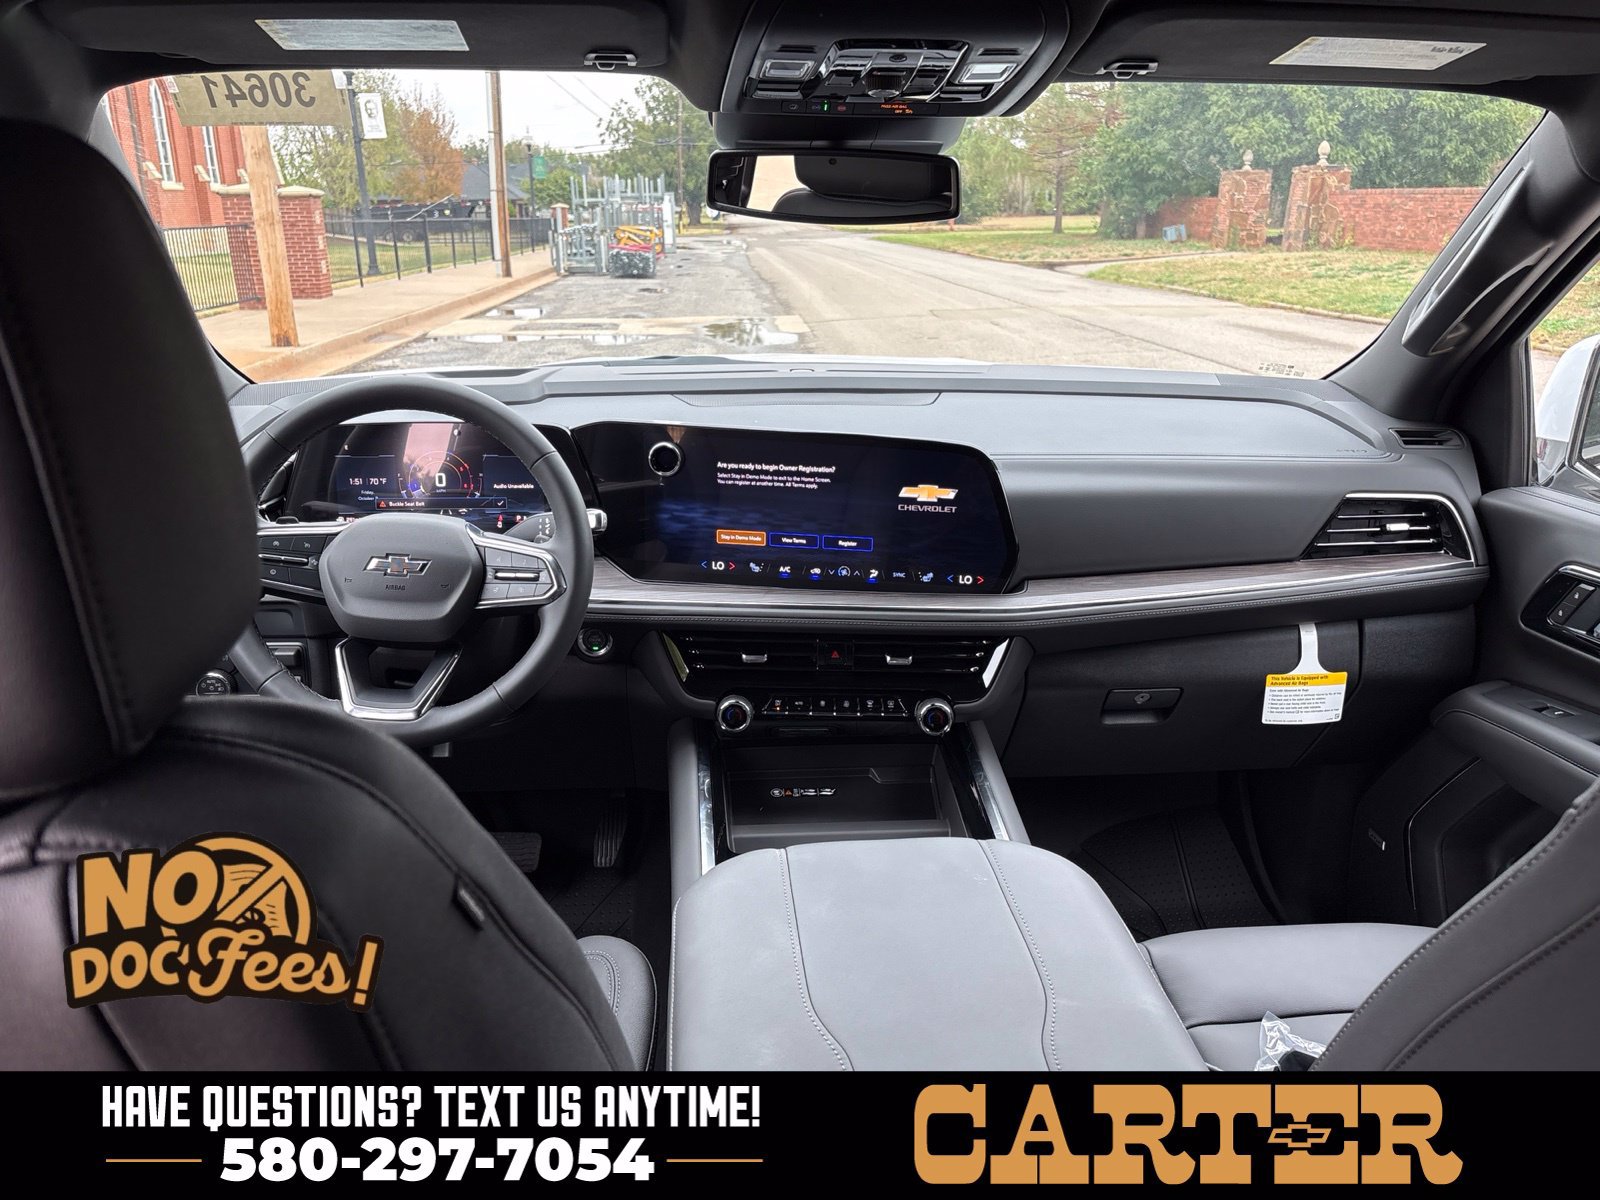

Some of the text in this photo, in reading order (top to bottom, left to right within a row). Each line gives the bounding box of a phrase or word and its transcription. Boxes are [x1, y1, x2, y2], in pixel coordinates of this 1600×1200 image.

[717, 461, 727, 469] Are
[739, 462, 754, 471] ready
[762, 463, 778, 472] begin
[798, 464, 836, 473] Registration?
[349, 477, 363, 486] 1:51
[369, 477, 379, 486] 70
[436, 472, 446, 487] 0
[897, 503, 958, 513] CHEVROLET
[711, 560, 725, 571] LO
[779, 565, 791, 573] A/C
[958, 574, 973, 585] LO
[385, 583, 406, 591] AIRBAG
